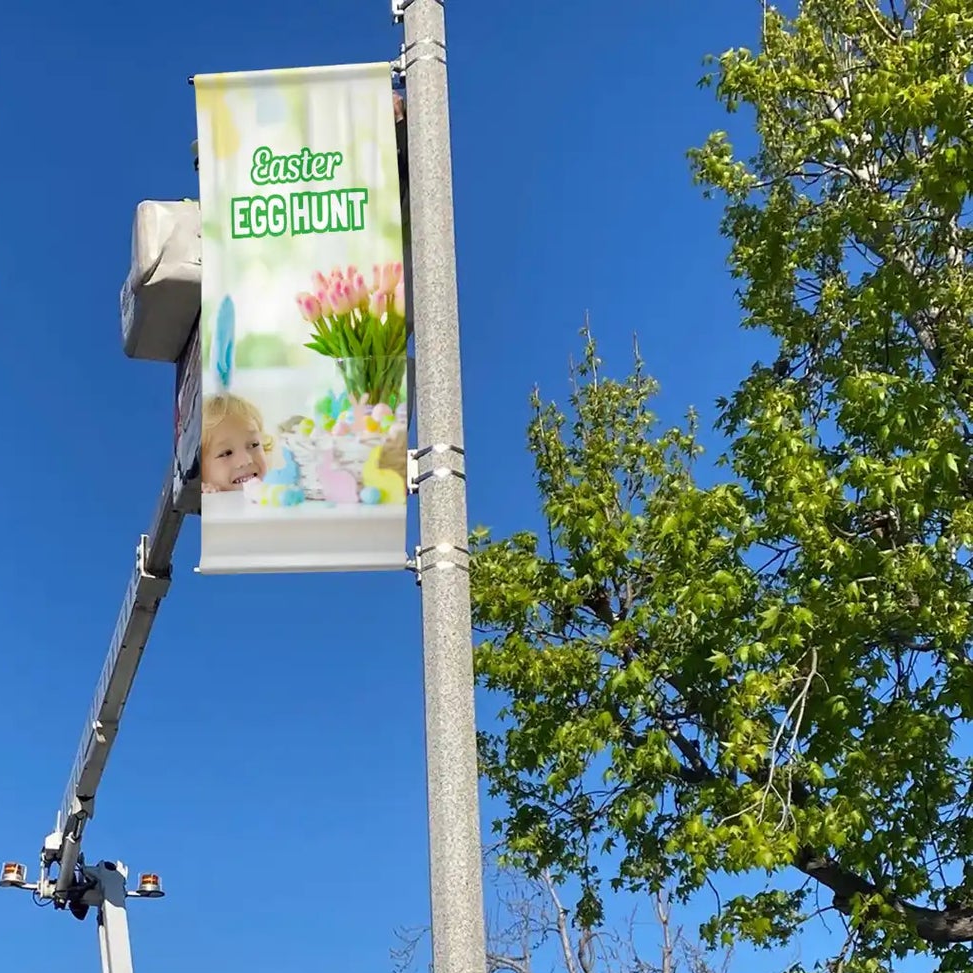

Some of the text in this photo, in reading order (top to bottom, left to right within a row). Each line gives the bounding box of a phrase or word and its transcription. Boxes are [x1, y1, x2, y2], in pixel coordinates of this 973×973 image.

[251, 146, 343, 185] Easter
[232, 188, 368, 238] EGG HUNT
